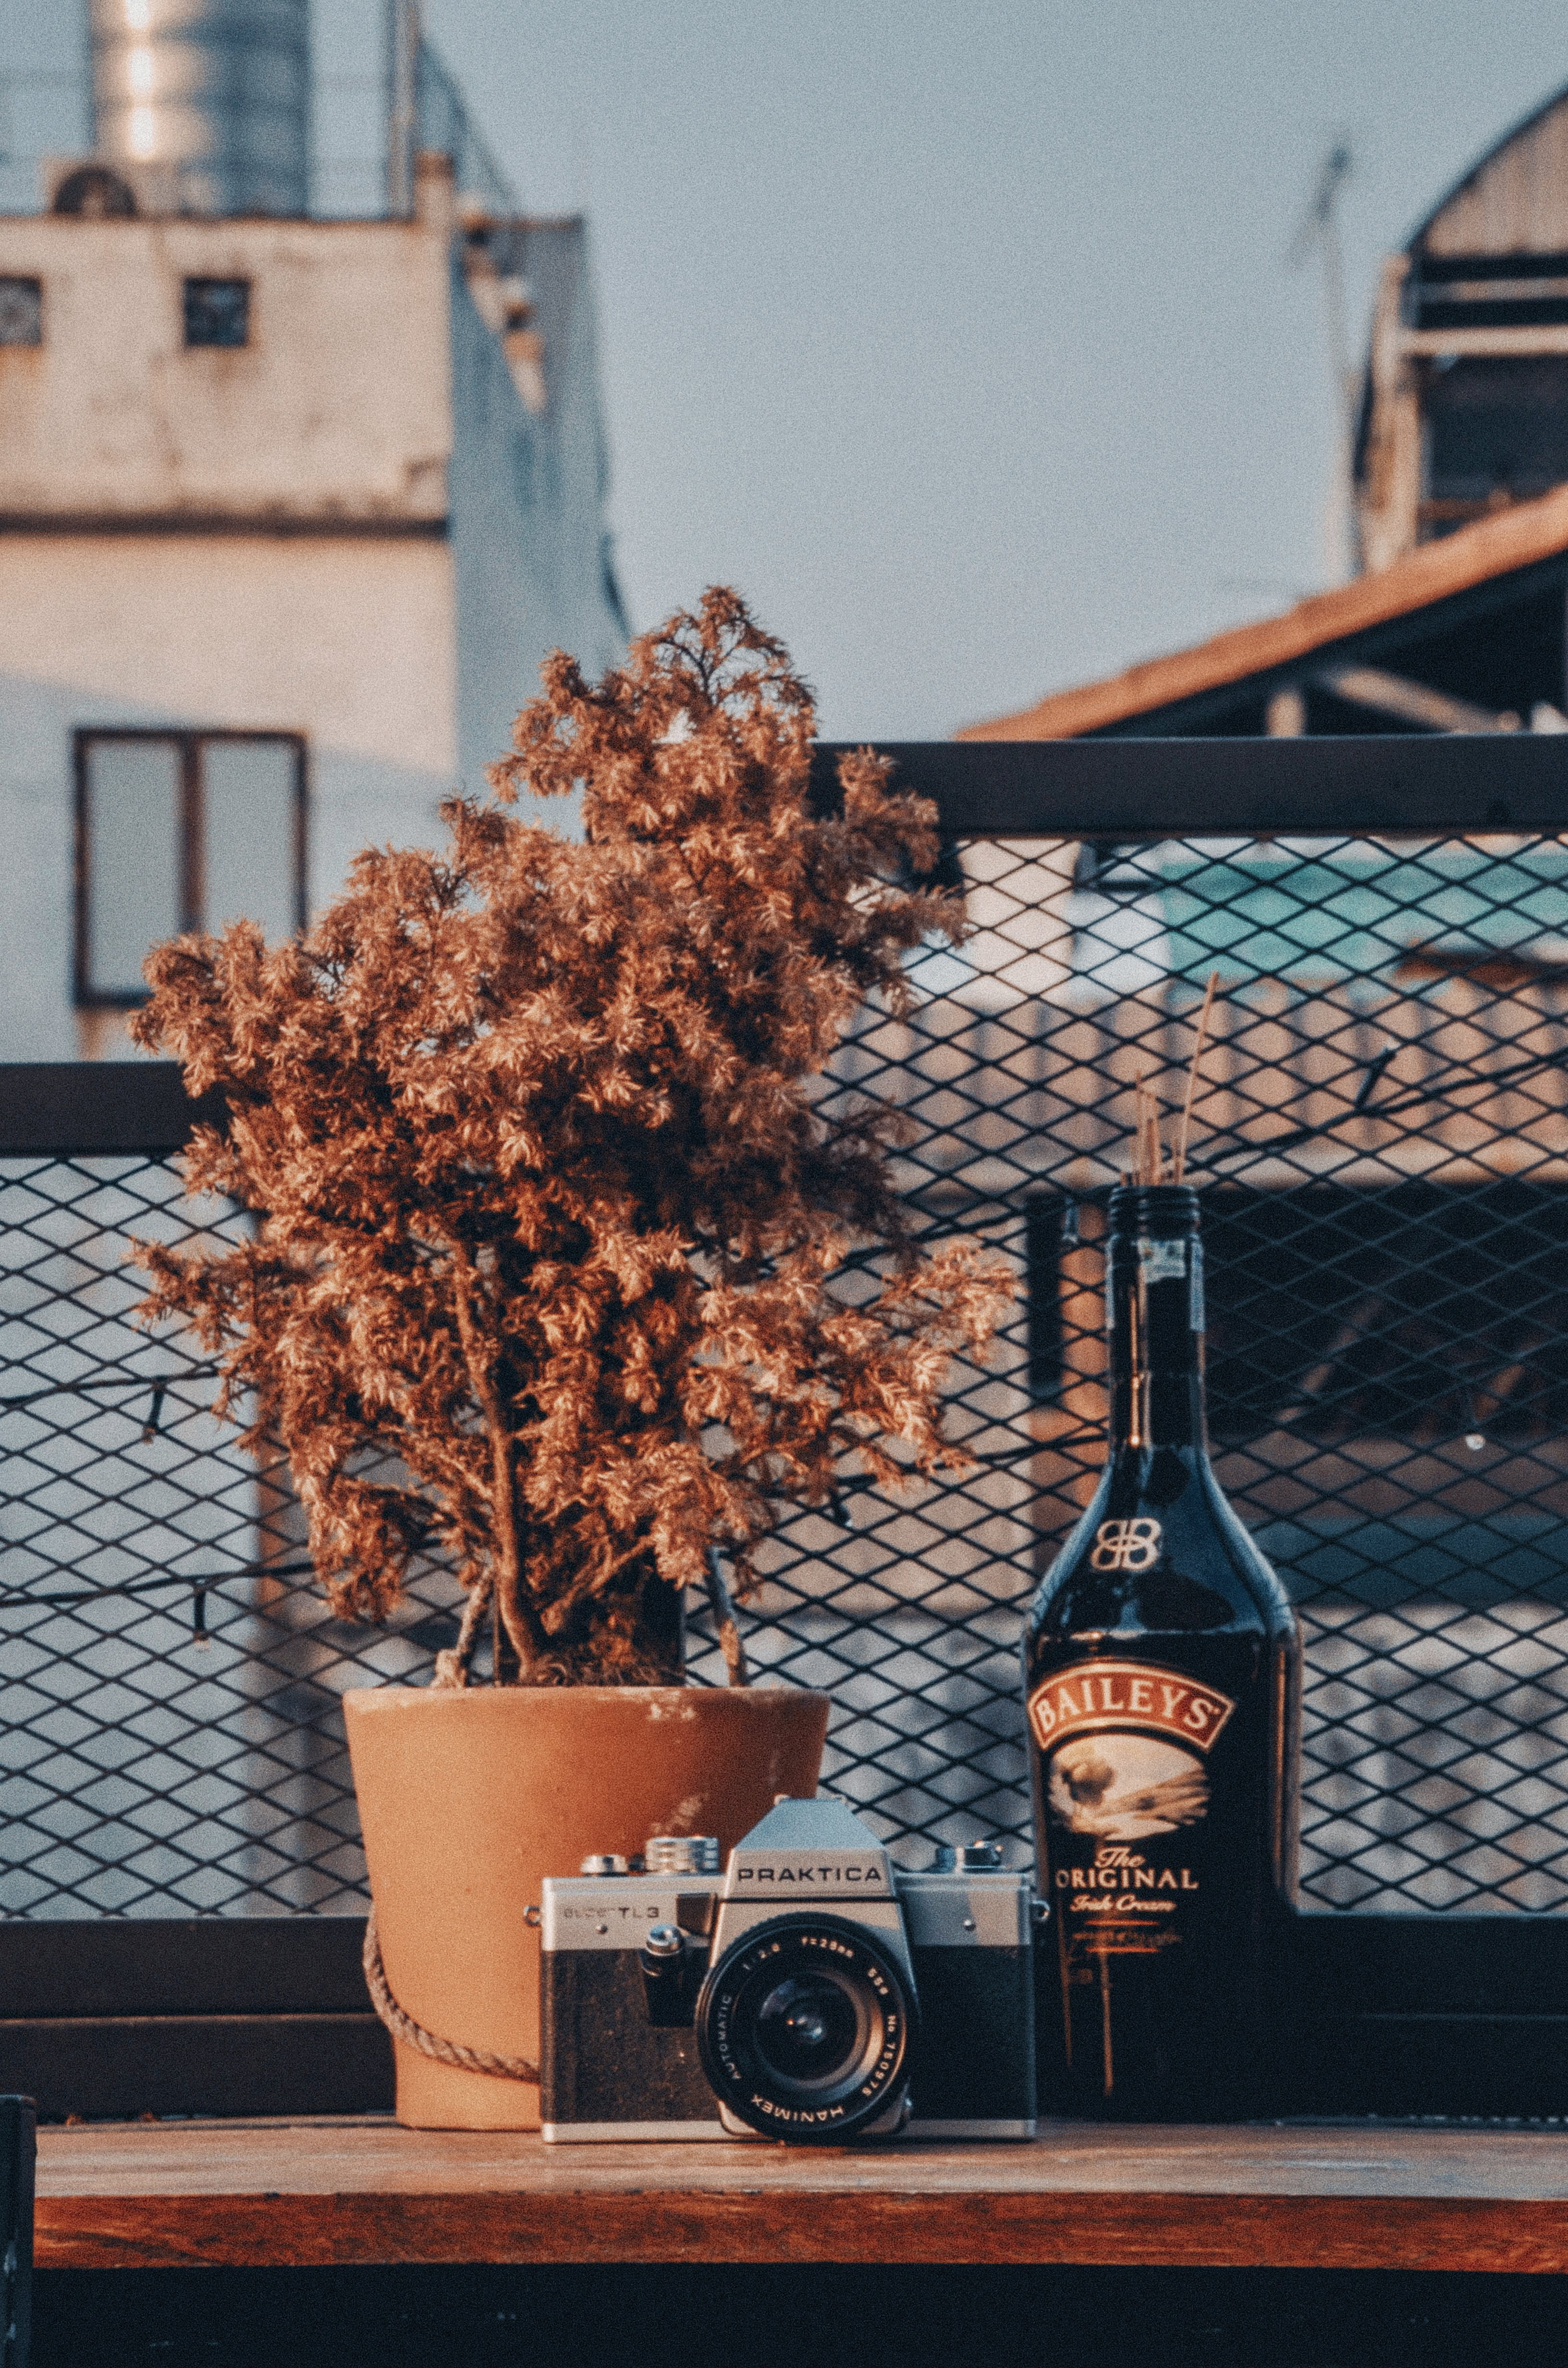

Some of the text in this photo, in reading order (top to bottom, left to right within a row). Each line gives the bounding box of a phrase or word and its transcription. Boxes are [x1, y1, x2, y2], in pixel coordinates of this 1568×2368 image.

[1036, 1677, 1214, 1734] BAILEYS
[1094, 1846, 1146, 1868] The
[738, 1866, 882, 1882] PRAKTICA
[1055, 1868, 1199, 1889] ORIGINAL
[718, 1995, 742, 2080] AUTOMATIC
[751, 2094, 844, 2122] HANIMEX
